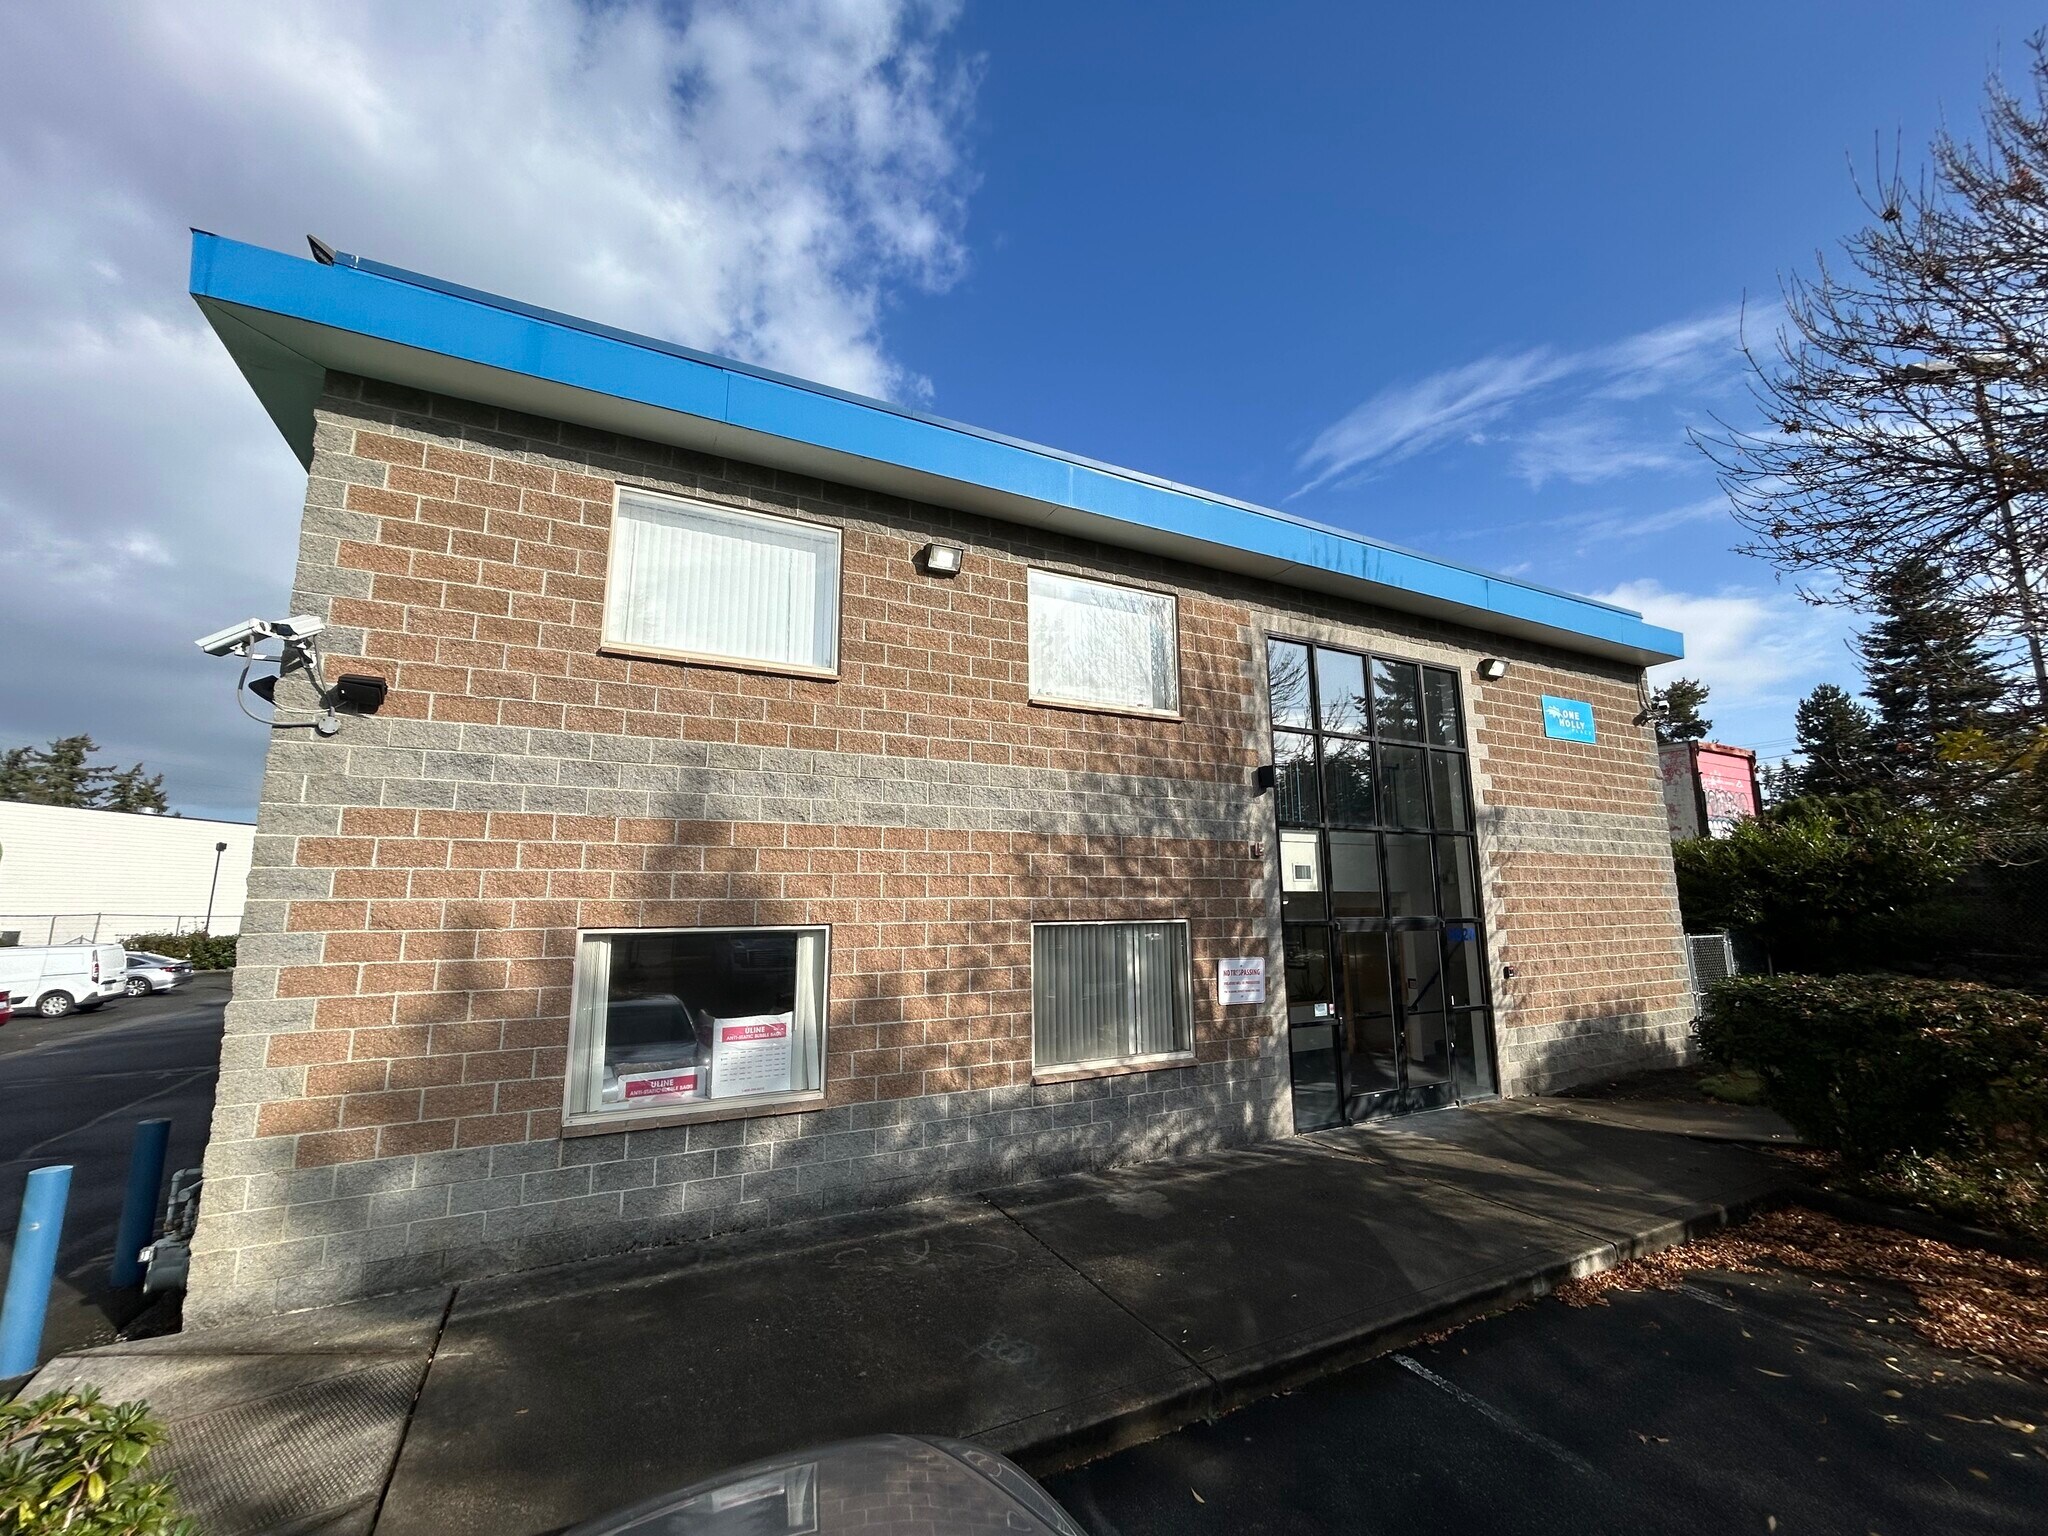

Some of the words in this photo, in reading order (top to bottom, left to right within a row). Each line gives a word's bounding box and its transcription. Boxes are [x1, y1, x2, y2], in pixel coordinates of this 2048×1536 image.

[1562, 710, 1580, 720] ONE
[1559, 719, 1585, 730] HOLLY
[745, 1026, 766, 1034] ULINE
[651, 1079, 674, 1088] ULINE
[629, 1087, 661, 1096] ANTI-STATIC
